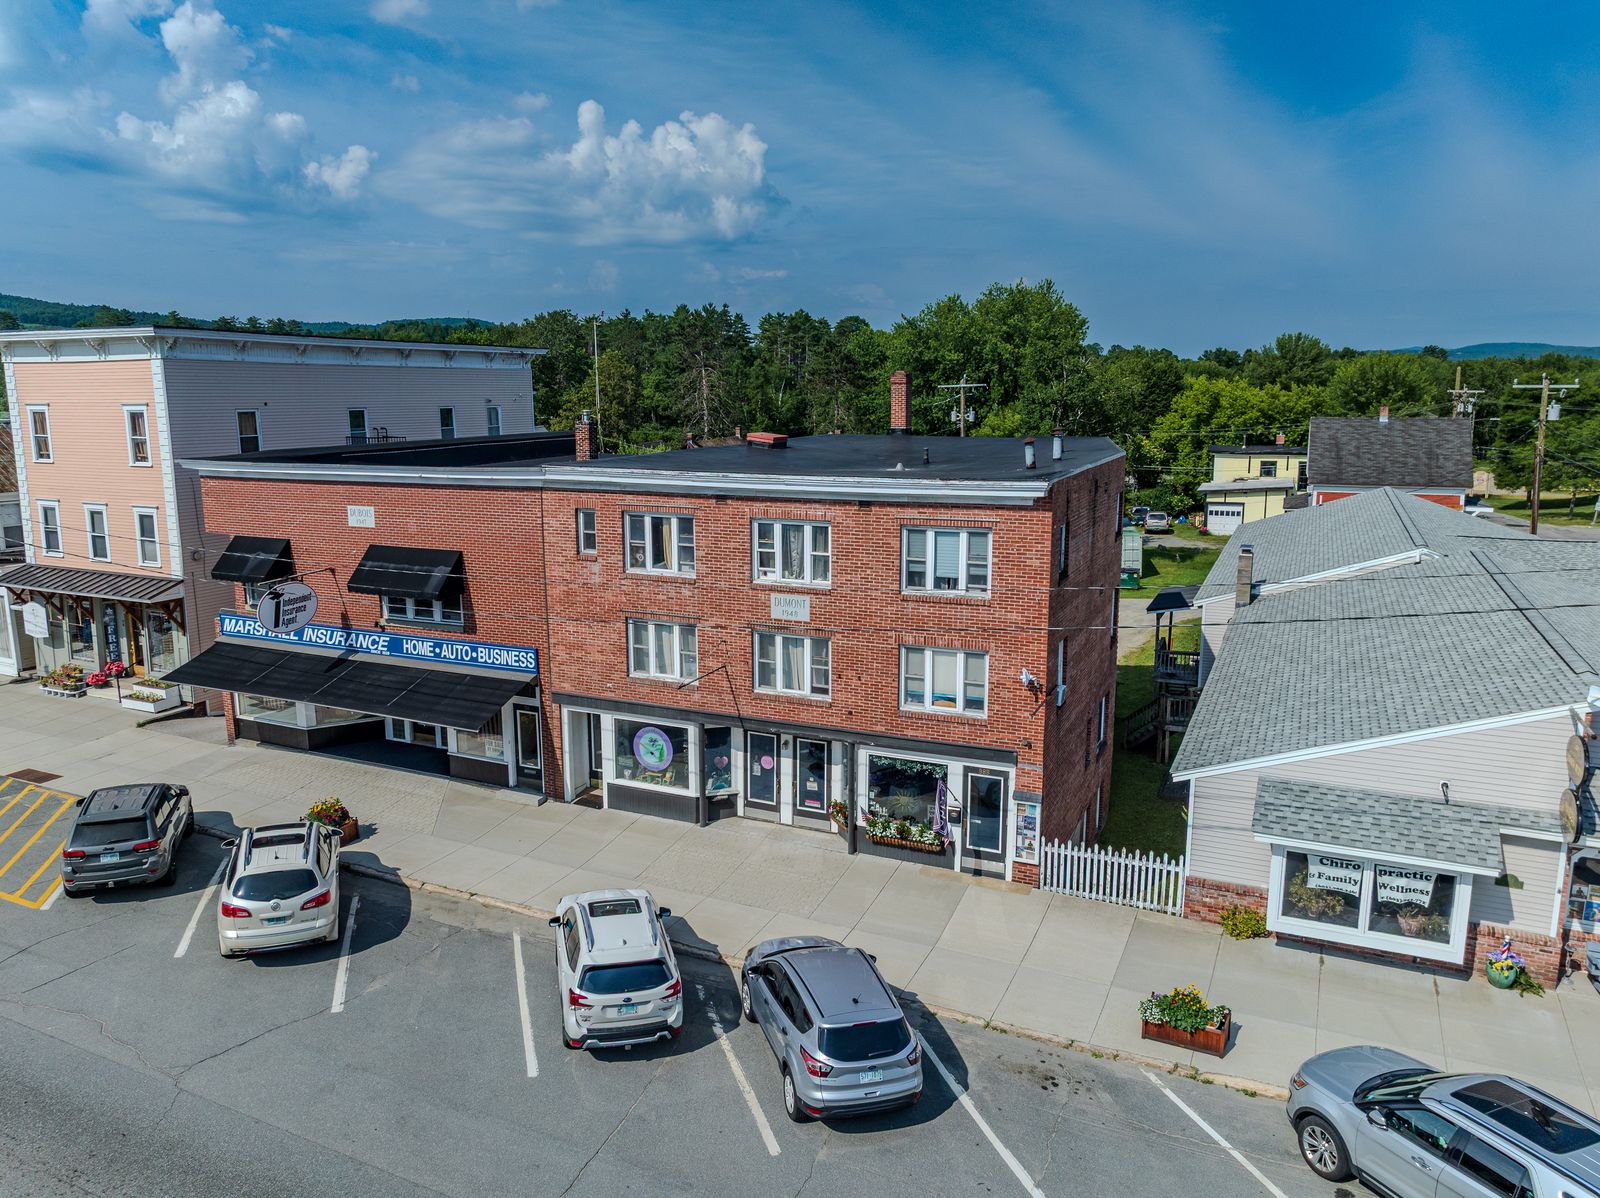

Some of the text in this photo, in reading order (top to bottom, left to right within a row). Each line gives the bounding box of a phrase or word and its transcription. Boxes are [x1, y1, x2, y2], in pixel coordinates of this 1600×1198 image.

[349, 508, 373, 518] DUBOIS
[281, 592, 312, 607] Independent
[774, 597, 807, 609] DUMONT
[281, 604, 307, 617] Insurance
[281, 614, 298, 628] Agent
[302, 627, 390, 651] INSURANCE
[403, 639, 536, 669] HOME AUTO BUSINESS
[1319, 857, 1361, 870] Chiro
[1317, 872, 1359, 886] Family
[1378, 869, 1433, 881] practic
[1378, 882, 1430, 897] Wellness
